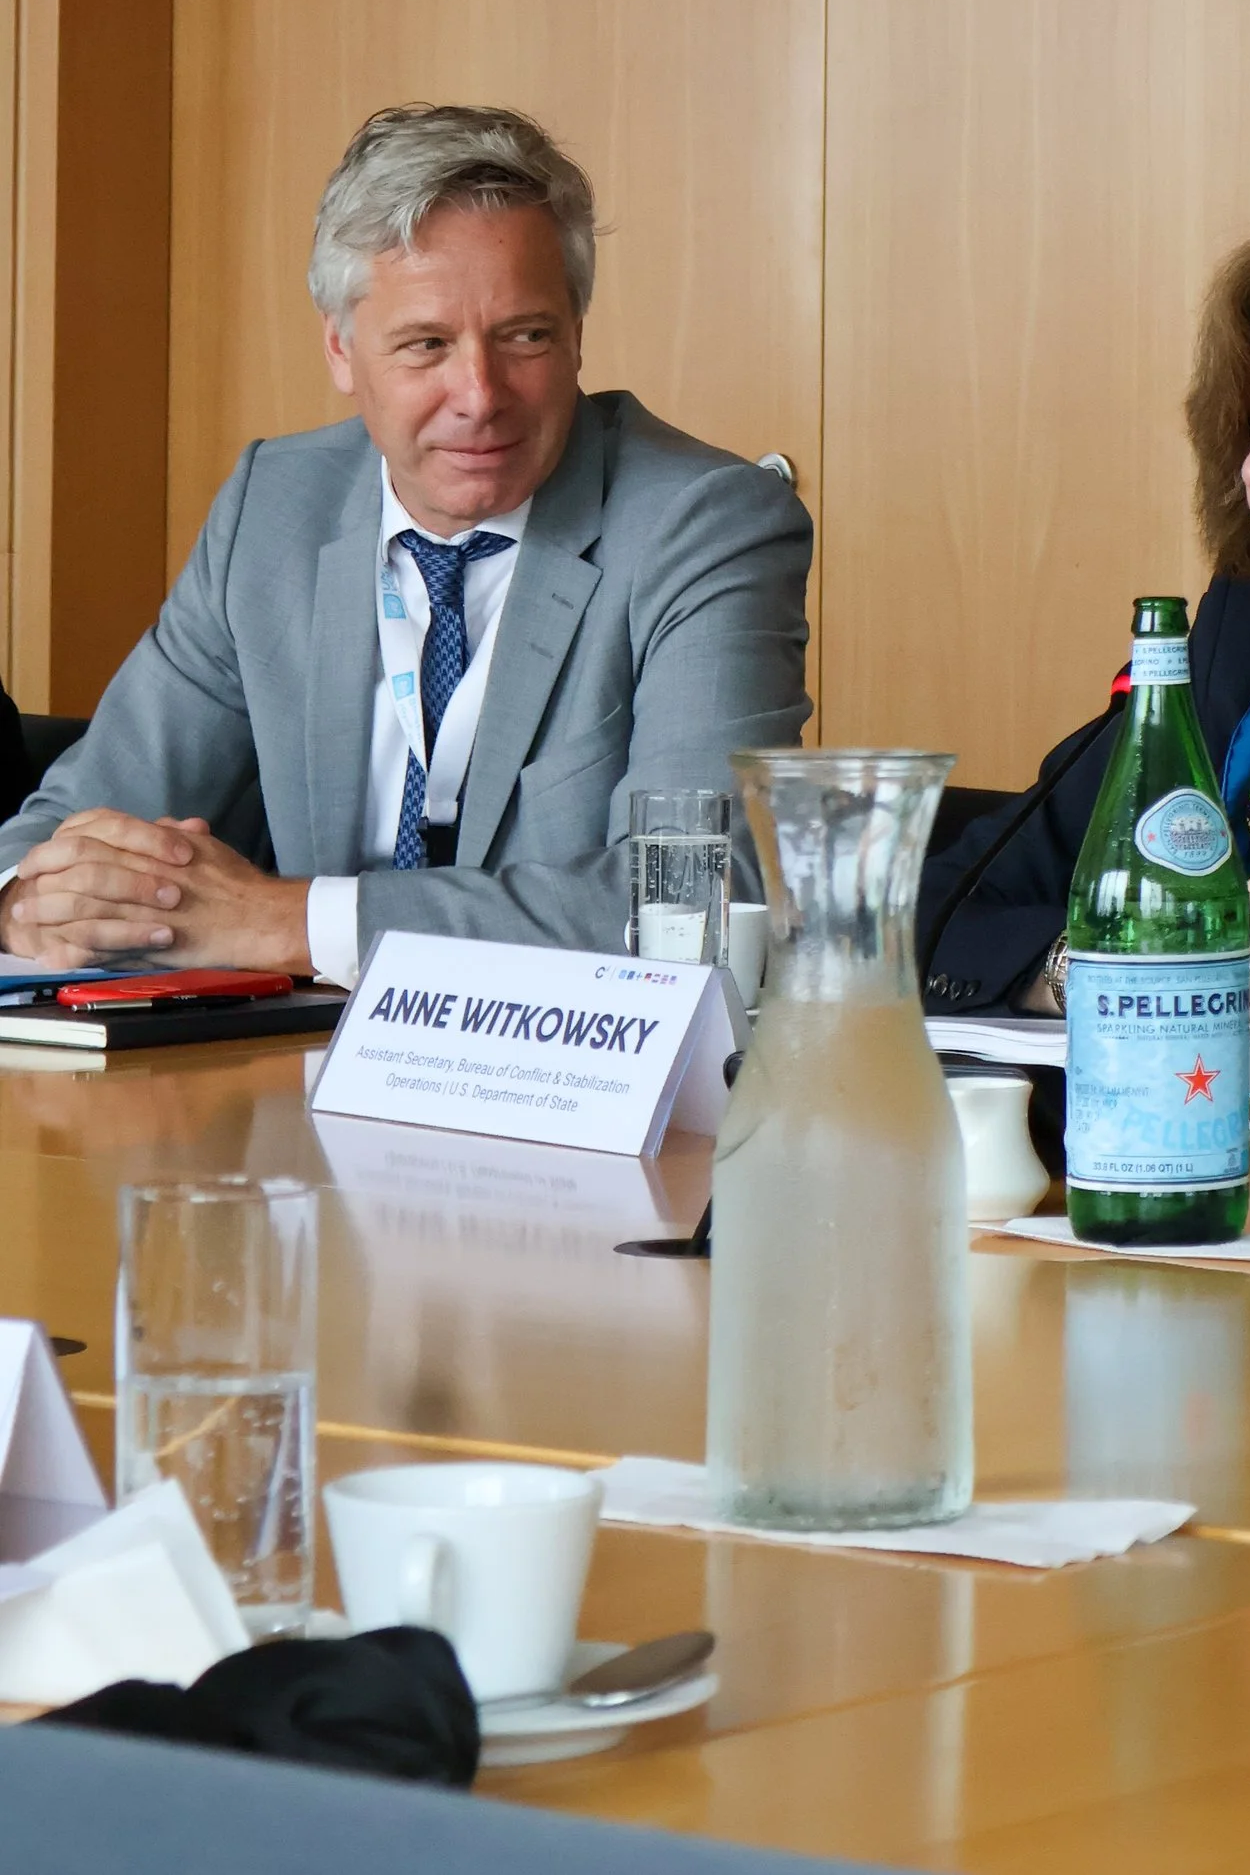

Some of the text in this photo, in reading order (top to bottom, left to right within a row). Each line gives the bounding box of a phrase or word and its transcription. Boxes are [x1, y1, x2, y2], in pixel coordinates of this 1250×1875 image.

[369, 987, 660, 1055] ANNE WITKOWSKY
[1096, 1023, 1155, 1035] SPARKLING
[1159, 1023, 1208, 1035] NATURAL
[356, 1044, 630, 1094] Assistant Secretary, Bureau of Conflict & Stabilization
[385, 1072, 442, 1091] Operations
[472, 1084, 535, 1107] Department
[535, 1093, 550, 1108] of
[549, 1094, 578, 1112] State
[1121, 1163, 1133, 1173] OZ
